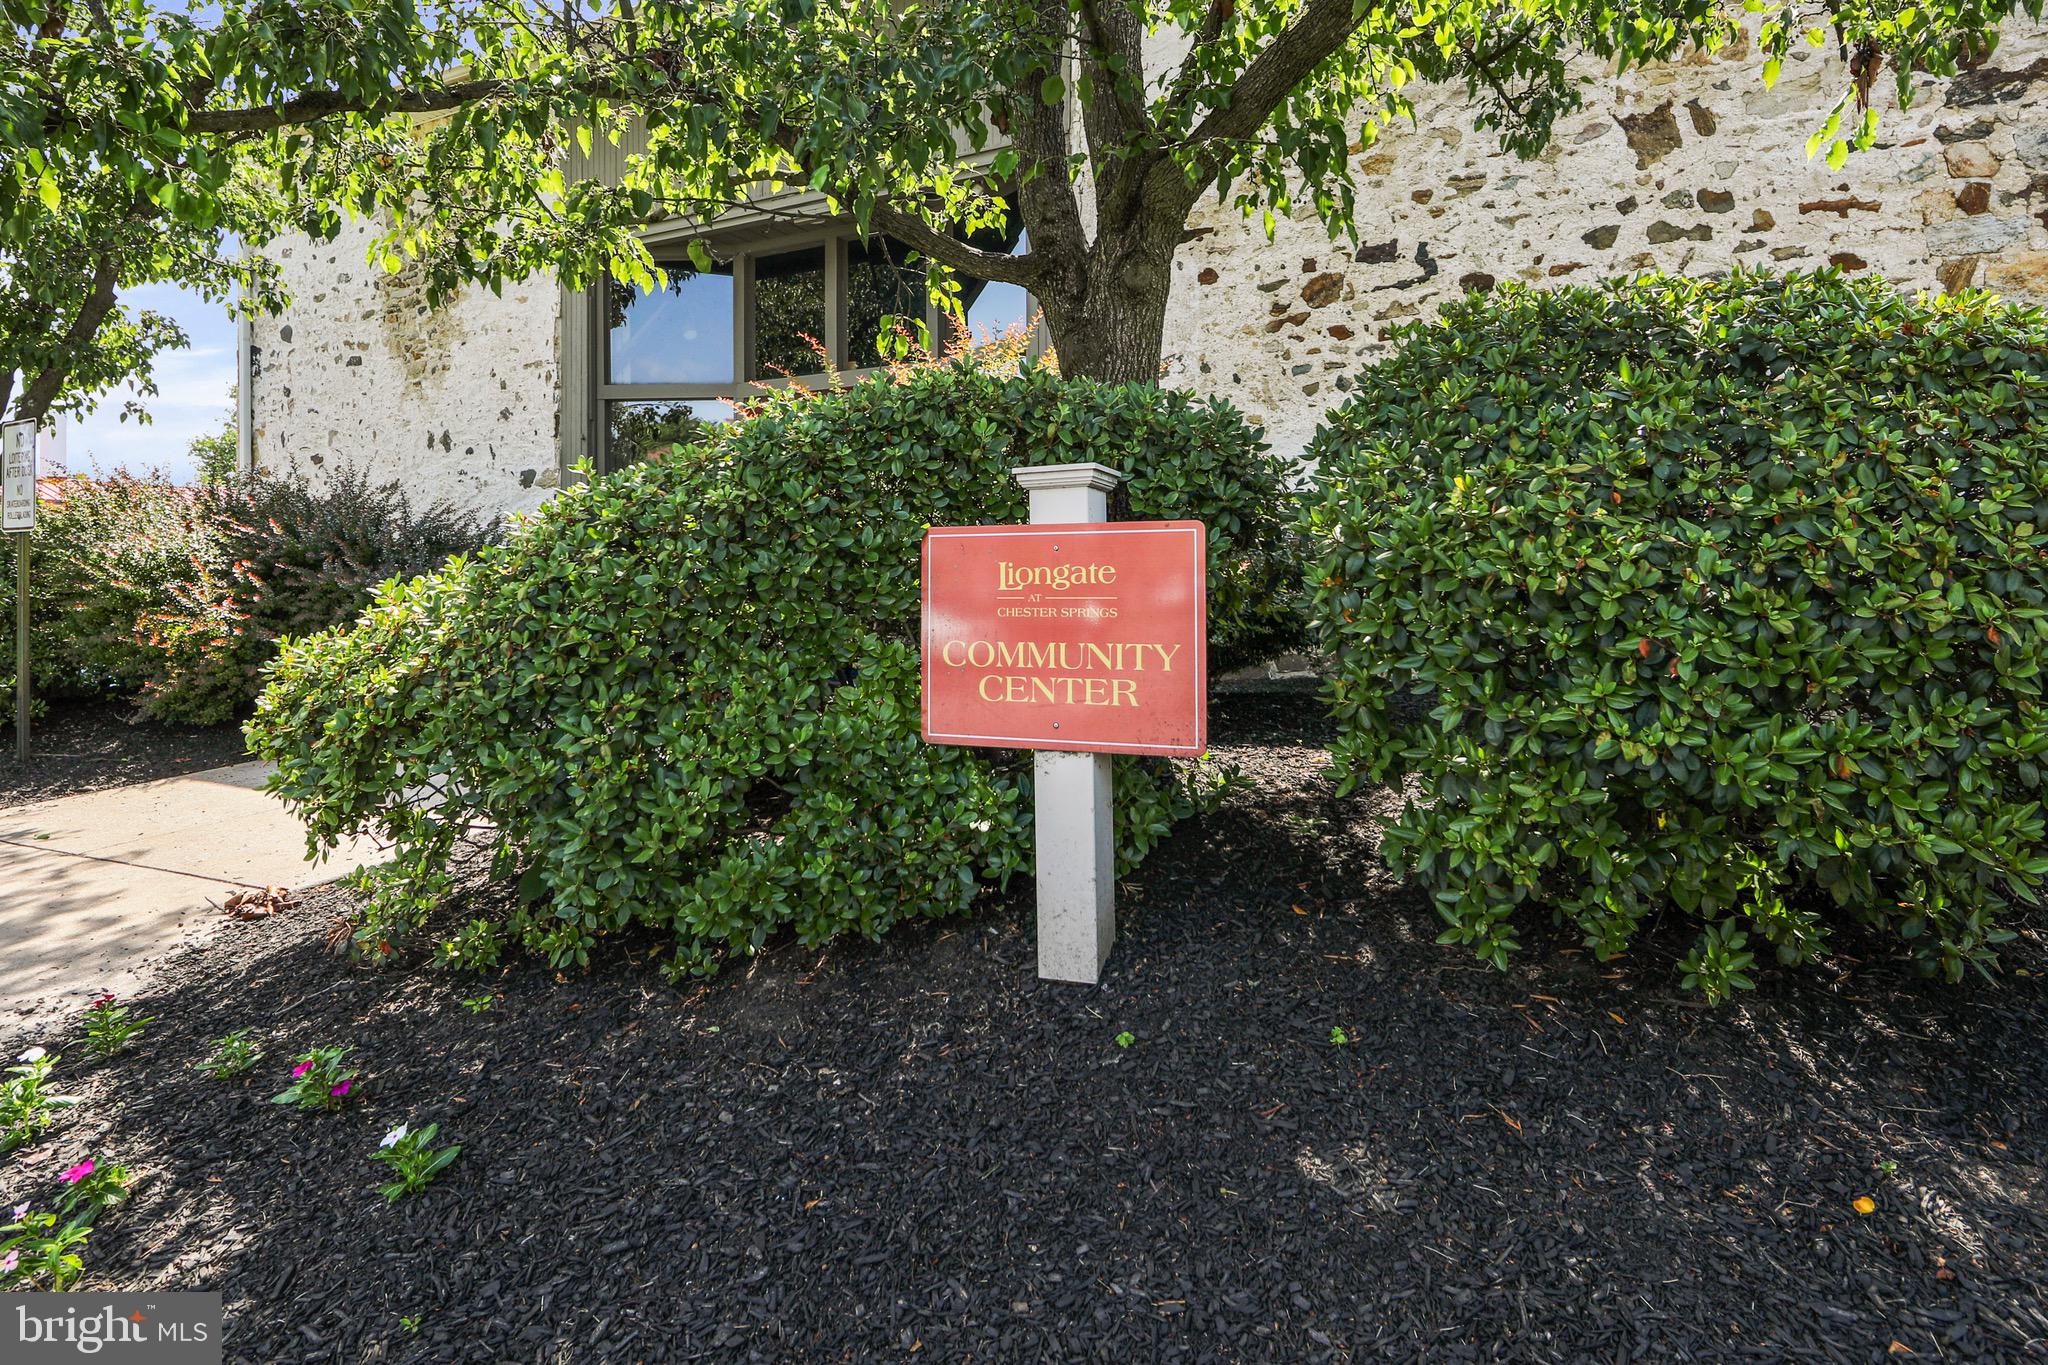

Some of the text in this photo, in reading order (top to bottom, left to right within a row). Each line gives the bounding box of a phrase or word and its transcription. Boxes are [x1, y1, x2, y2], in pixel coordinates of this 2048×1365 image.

[16, 432, 25, 448] NO
[6, 466, 20, 479] AFTER
[16, 484, 23, 496] NO
[997, 561, 1117, 591] Liongate
[1027, 594, 1042, 603] AT
[997, 607, 1118, 618] CHESTER SPRINGS
[942, 640, 1181, 672] COMMUNITY
[978, 675, 1140, 707] CENTER
